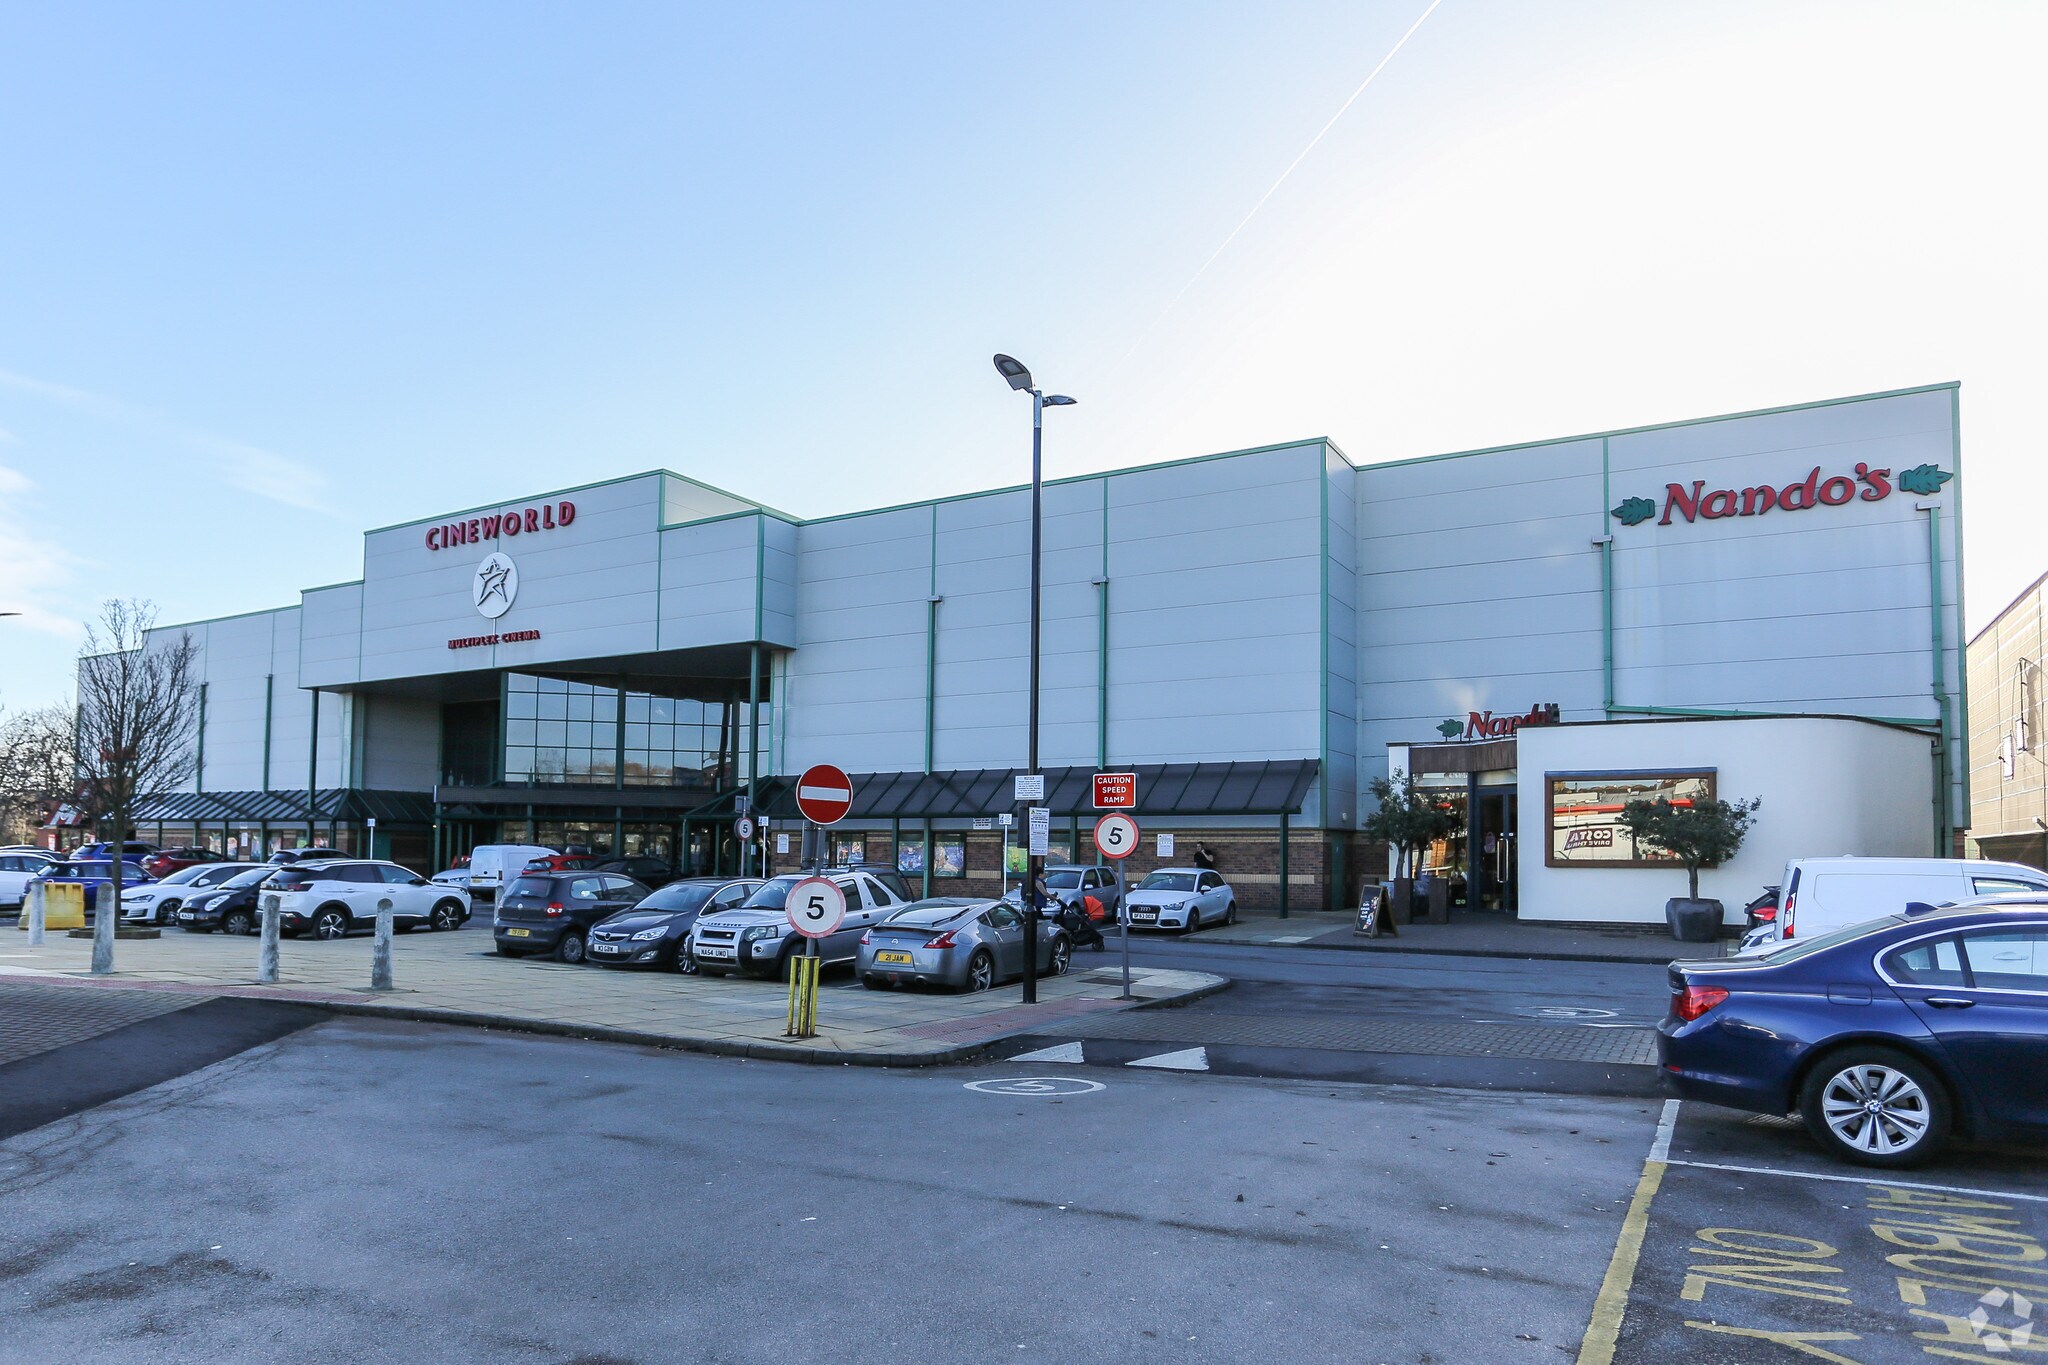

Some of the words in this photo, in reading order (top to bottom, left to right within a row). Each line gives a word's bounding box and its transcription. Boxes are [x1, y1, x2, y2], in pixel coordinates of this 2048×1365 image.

[1658, 462, 1892, 525] Nando's
[425, 501, 576, 550] CINEWORLD
[448, 634, 500, 649] MULTIPLEX
[501, 630, 540, 643] CINEMA
[742, 824, 748, 834] 5
[1108, 826, 1123, 845] 5
[806, 896, 825, 920] 5
[998, 1080, 1055, 1091] 5
[1680, 1227, 1863, 1365] ONLY
